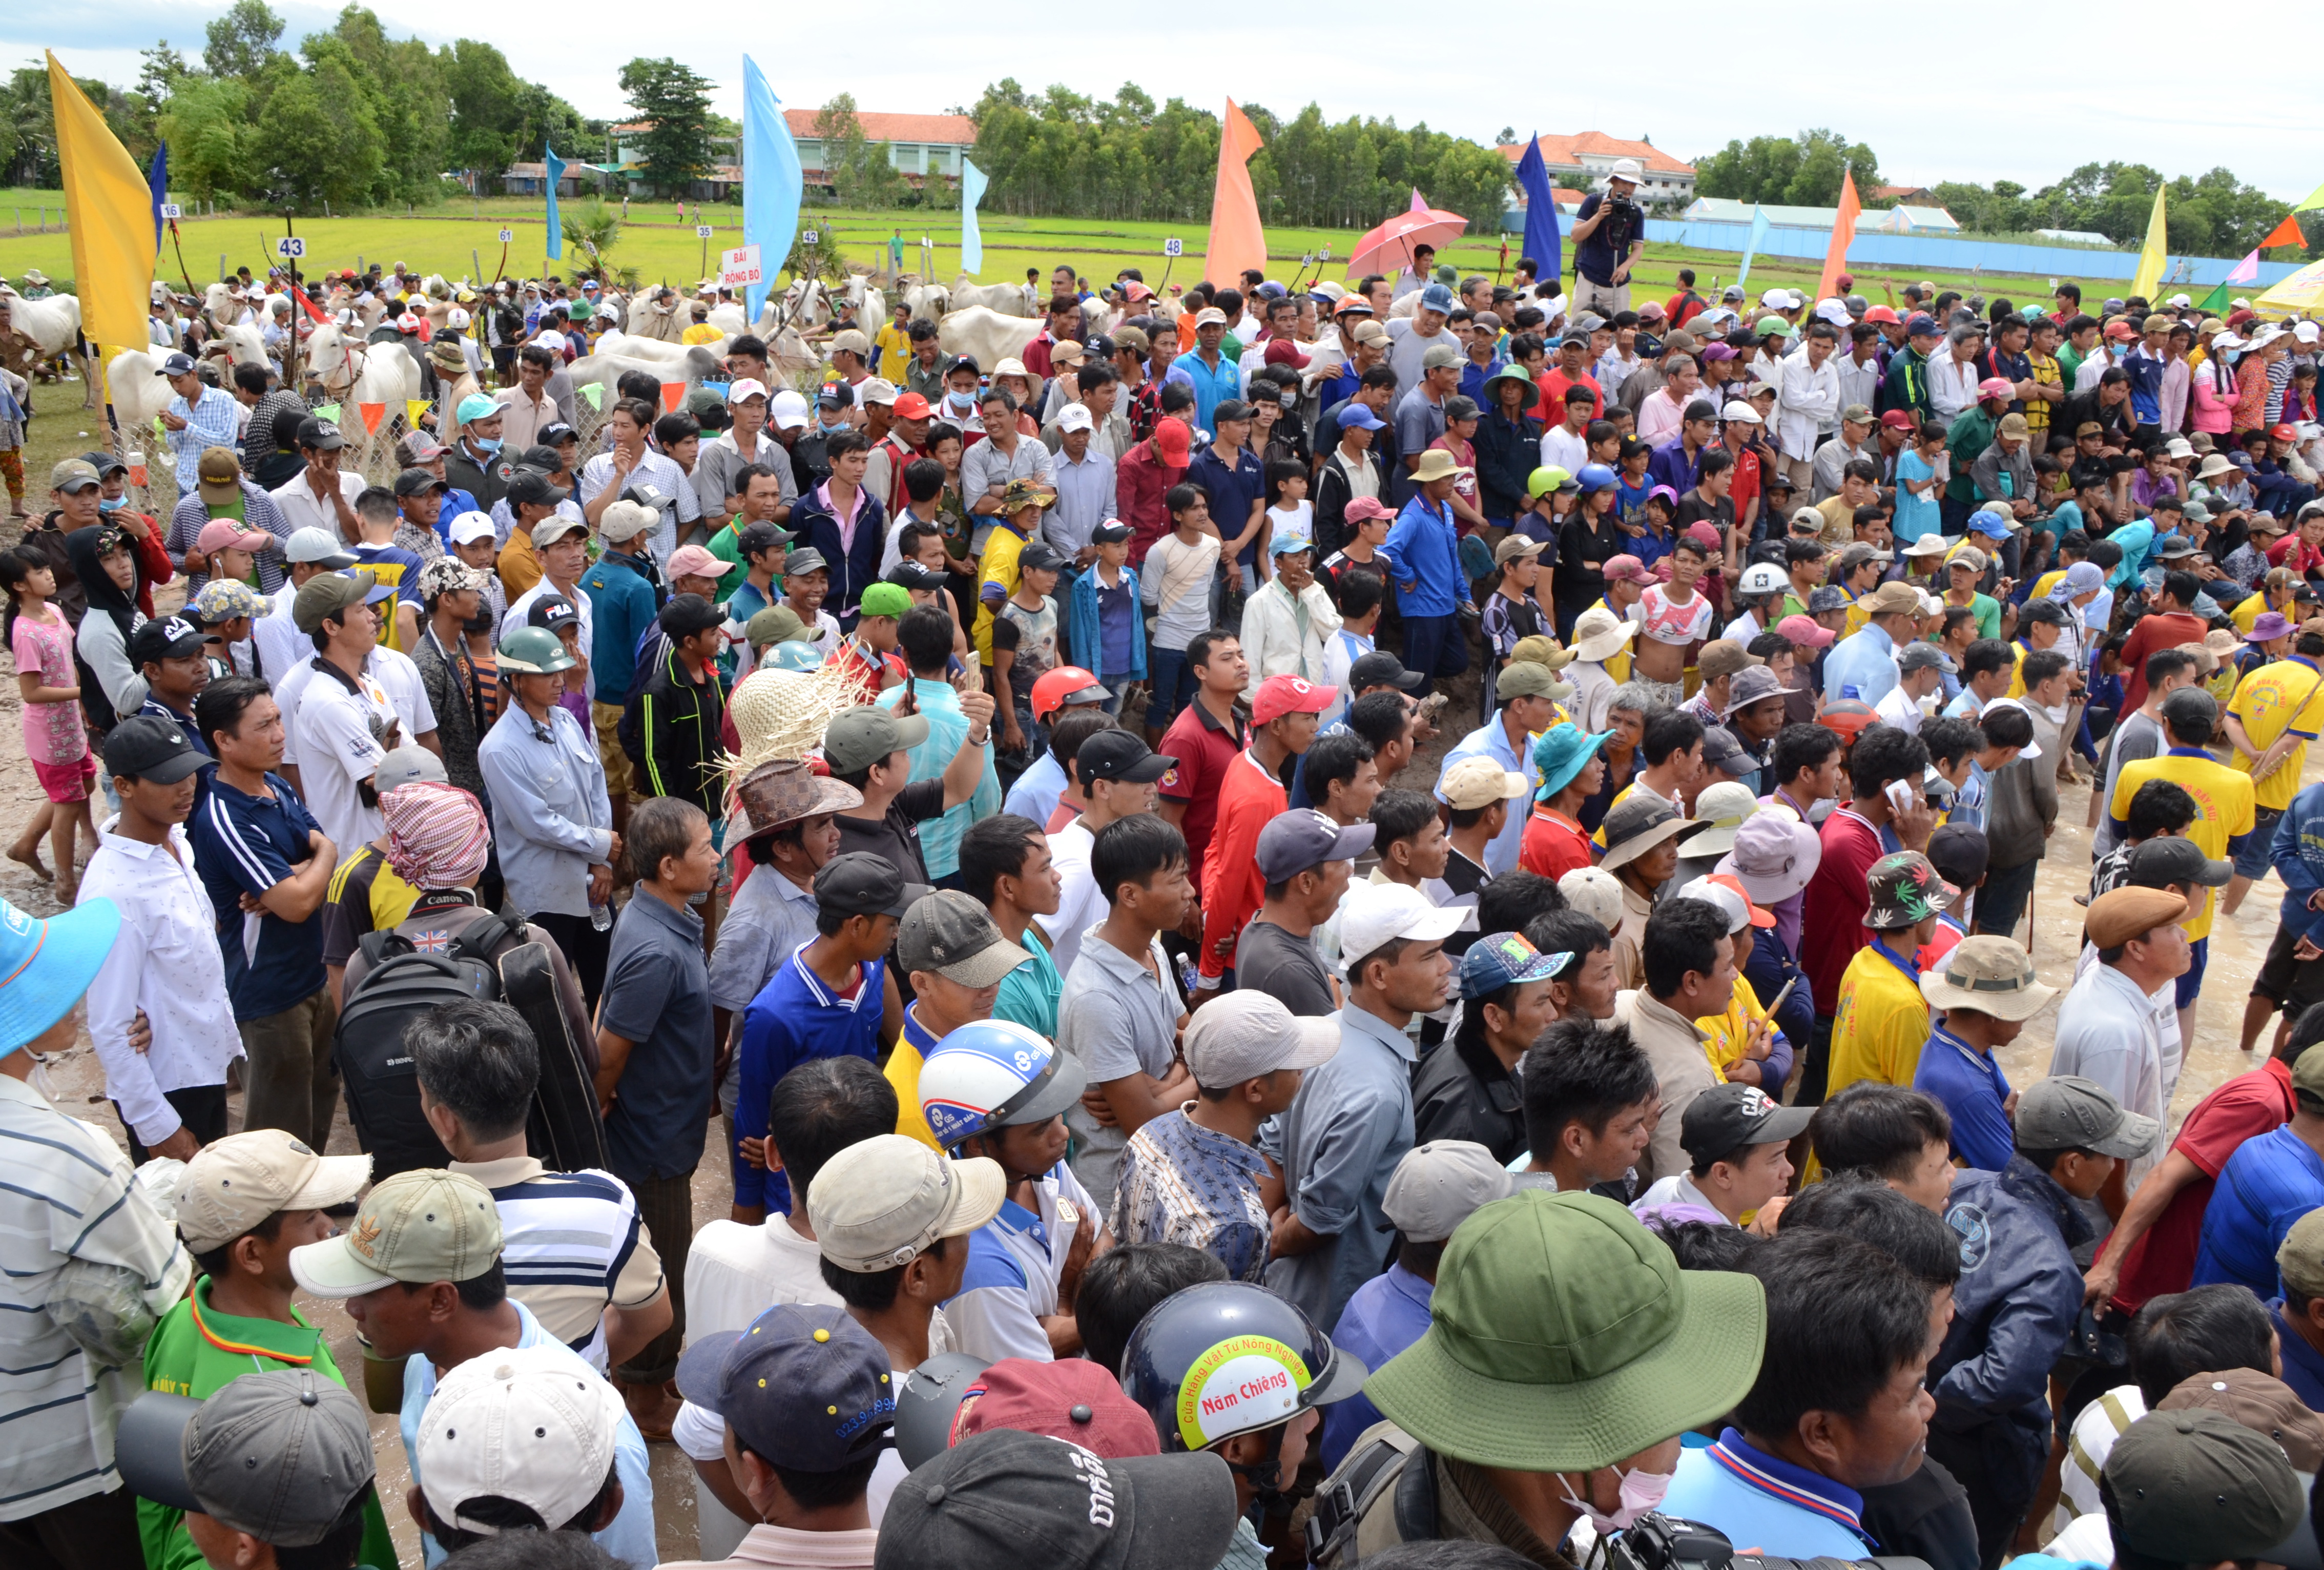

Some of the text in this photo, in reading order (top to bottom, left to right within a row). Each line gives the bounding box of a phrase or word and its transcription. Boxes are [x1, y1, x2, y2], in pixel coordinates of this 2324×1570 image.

[165, 205, 177, 216] 16
[500, 231, 511, 240] 61
[699, 228, 710, 236] 35
[804, 232, 816, 242] 42
[280, 239, 302, 255] 43
[1167, 240, 1179, 254] 48
[734, 249, 746, 263] BÃI
[725, 265, 759, 286] RỘNG BÒ
[545, 604, 572, 619] FILA
[428, 895, 463, 904] Canon
[1031, 1048, 1041, 1060] GS
[944, 1113, 955, 1123] GS
[1182, 1338, 1304, 1423] Cửa Hàng Vật Tư Nông Nghiệp
[1201, 1371, 1288, 1416] Năm Chiêng
